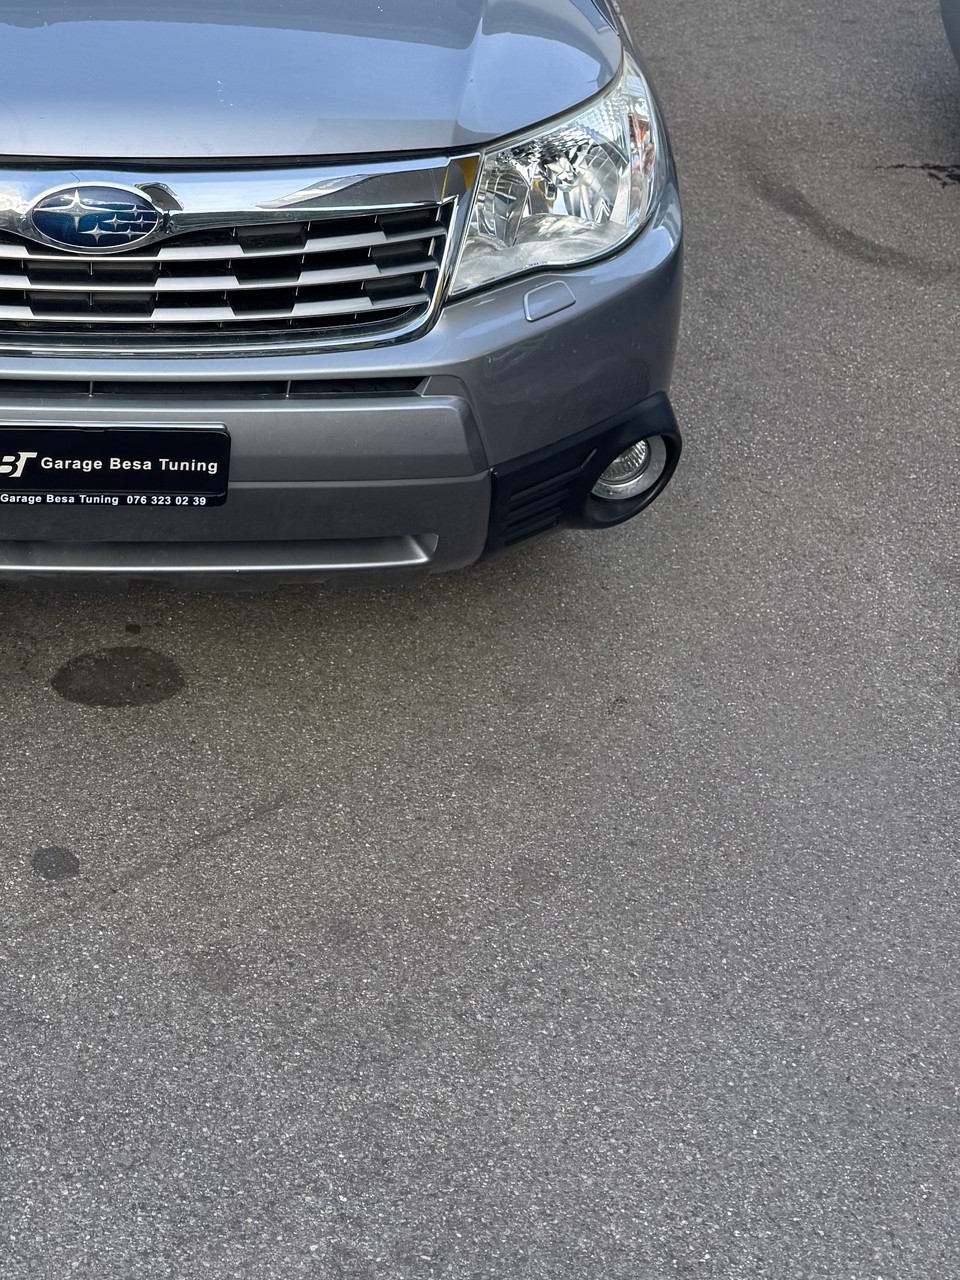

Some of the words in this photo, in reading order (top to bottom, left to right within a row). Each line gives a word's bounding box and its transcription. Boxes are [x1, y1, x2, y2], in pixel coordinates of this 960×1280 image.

[40, 457, 103, 472] Garage
[109, 458, 152, 470] Besa
[159, 458, 218, 474] Tuning
[0, 494, 42, 504] Garage
[46, 494, 75, 503] Besa
[79, 495, 119, 505] Tuning
[126, 495, 147, 505] 076
[151, 496, 171, 505] 323
[175, 496, 189, 505] 02
[193, 497, 207, 506] 39
